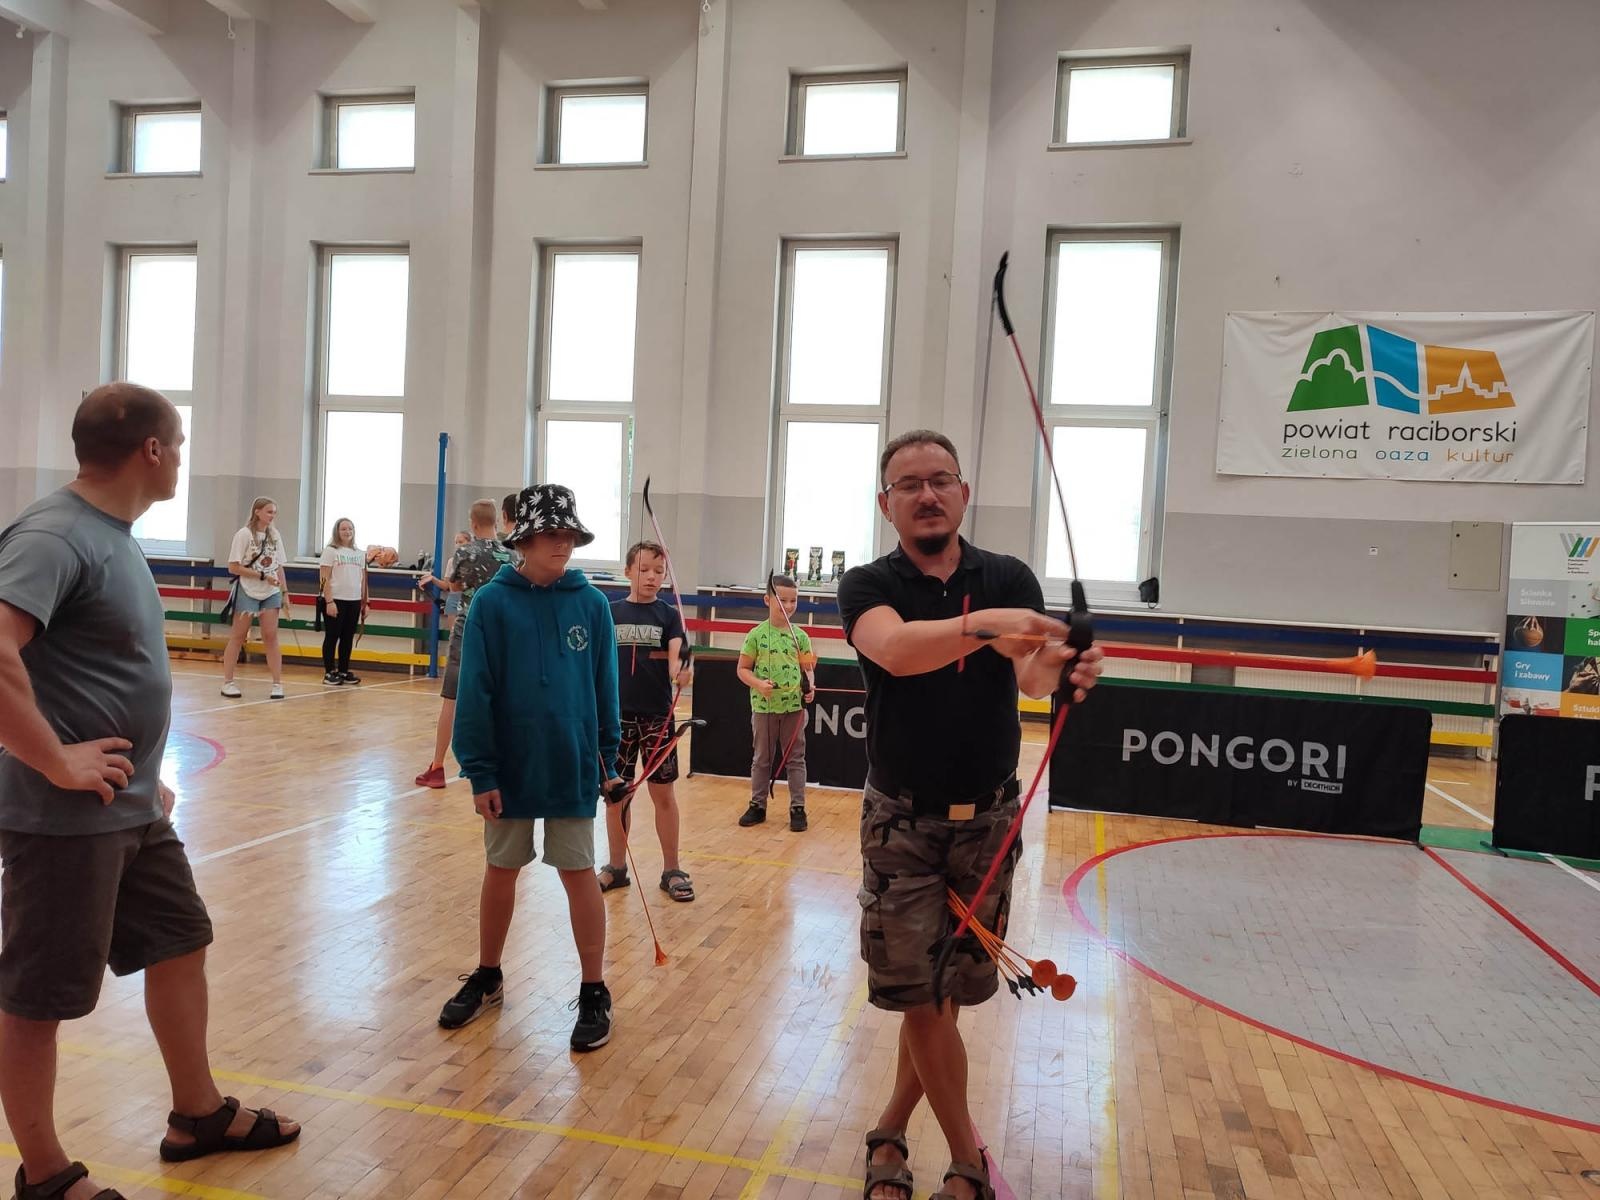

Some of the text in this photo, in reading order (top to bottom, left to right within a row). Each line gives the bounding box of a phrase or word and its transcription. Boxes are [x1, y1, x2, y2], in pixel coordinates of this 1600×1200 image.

[1283, 418, 1517, 444] powiat raciborski
[1281, 444, 1515, 464] zielona oaza kultur
[1515, 661, 1531, 670] Gry
[1519, 672, 1551, 681] zabawy
[1121, 728, 1347, 780] PONGORI
